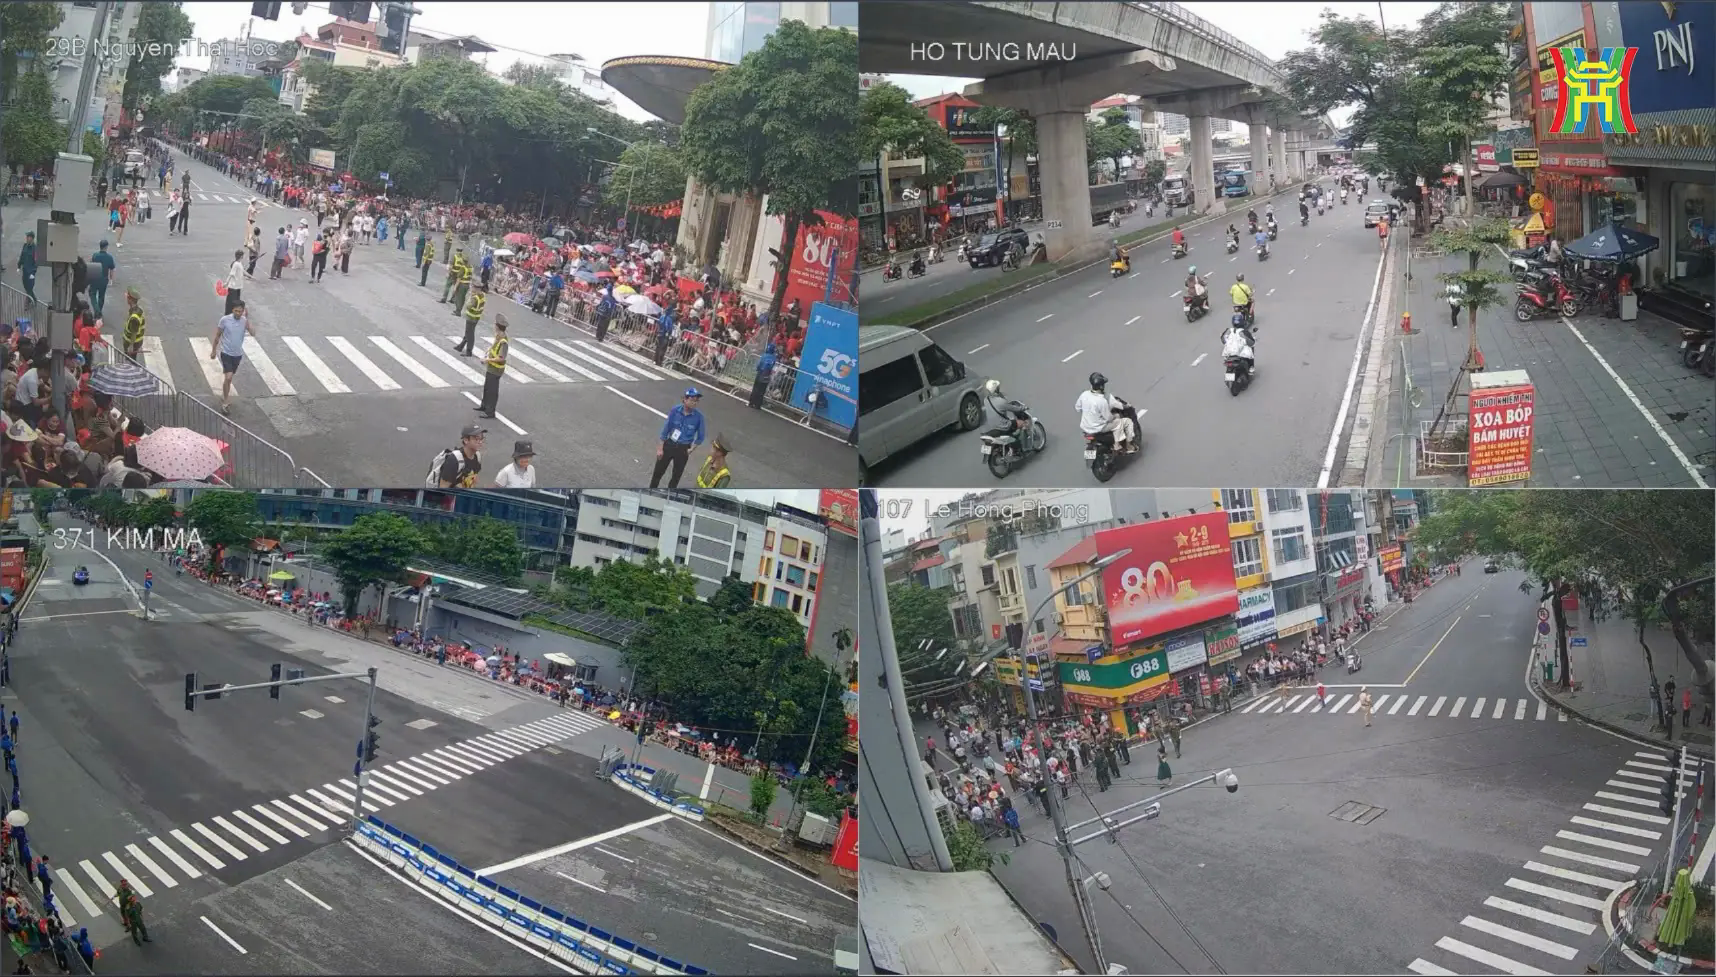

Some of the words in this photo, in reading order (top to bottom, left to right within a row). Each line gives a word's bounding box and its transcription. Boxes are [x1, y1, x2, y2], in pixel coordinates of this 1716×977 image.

[1654, 22, 1694, 76] PNJ
[822, 319, 840, 328] VNPT
[1474, 410, 1503, 428] XOA
[1506, 404, 1532, 424] BÓP
[1500, 424, 1530, 440] HUYỆT
[1190, 525, 1208, 542] 2-9
[1121, 561, 1175, 604] 80
[1130, 658, 1160, 678] F88
